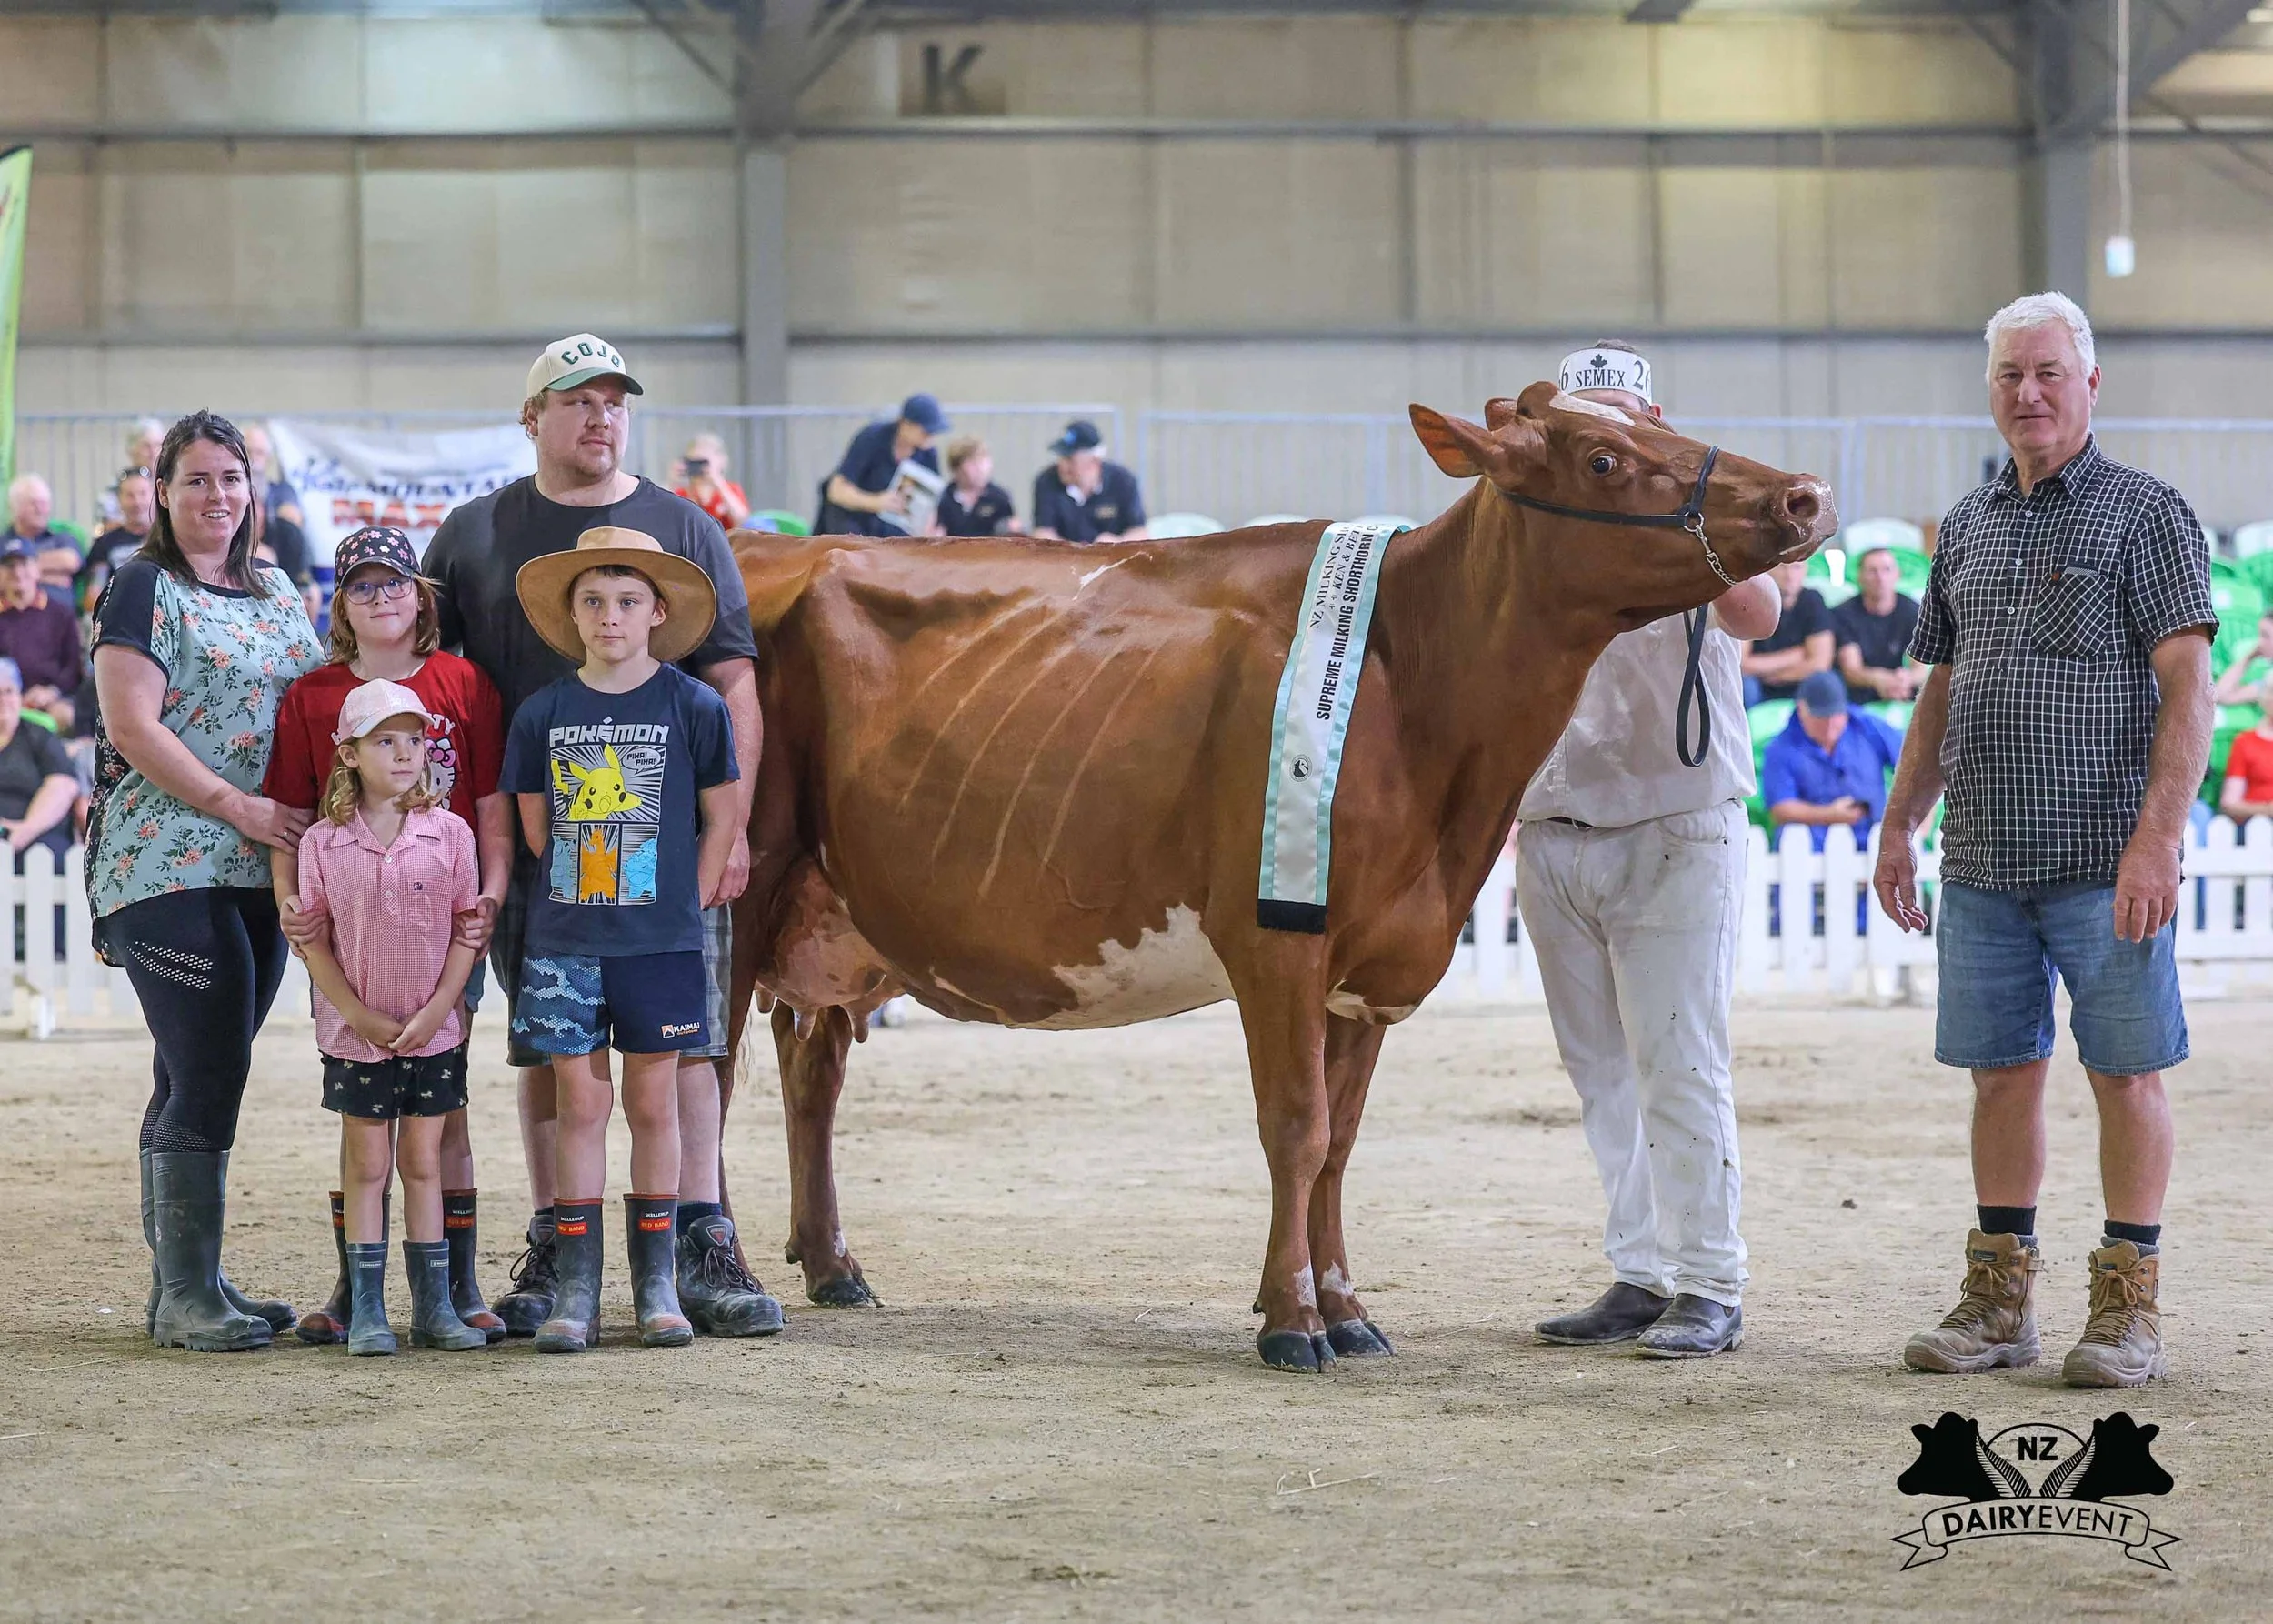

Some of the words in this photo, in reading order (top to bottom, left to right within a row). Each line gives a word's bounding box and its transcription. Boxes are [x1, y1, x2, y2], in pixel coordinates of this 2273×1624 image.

[922, 44, 983, 115] K
[561, 342, 620, 368] COJO
[1576, 369, 1626, 387] SEMEX
[1316, 546, 1340, 607] MILKING
[1333, 564, 1346, 589] KEN
[1341, 554, 1352, 562] &
[1310, 610, 1324, 628] NZ
[1317, 660, 1342, 720] SUPREME
[1331, 606, 1354, 658] MILKING
[1343, 534, 1374, 602] SHORTHORN
[549, 716, 670, 747] POKÉMON
[674, 1022, 700, 1032] KAIMAI
